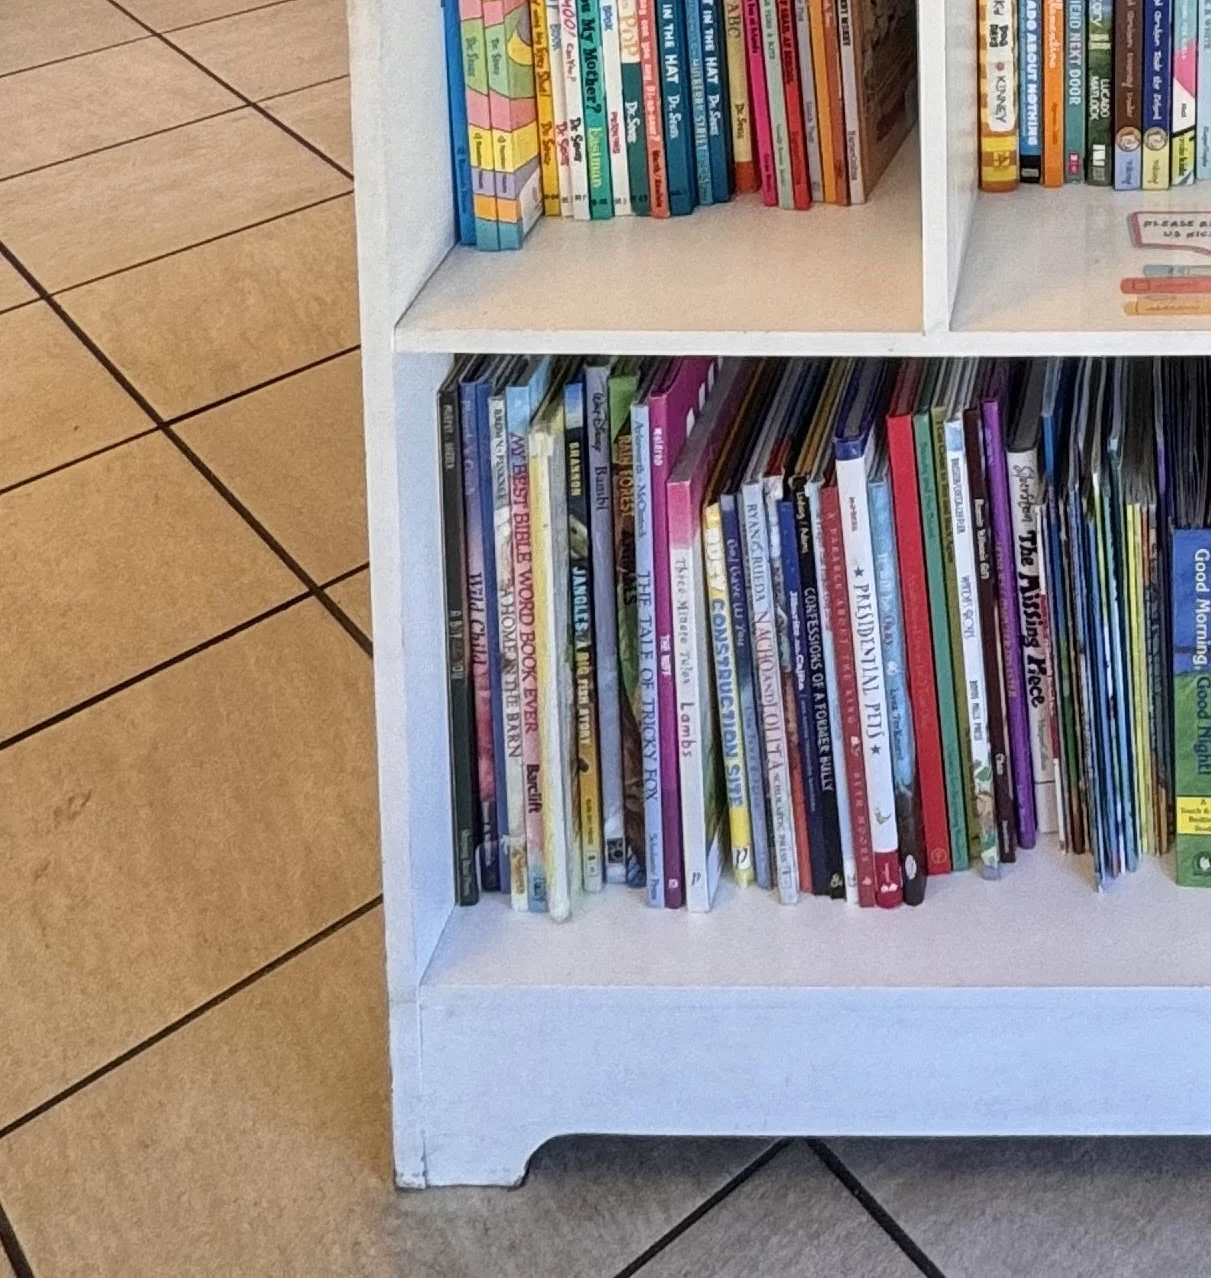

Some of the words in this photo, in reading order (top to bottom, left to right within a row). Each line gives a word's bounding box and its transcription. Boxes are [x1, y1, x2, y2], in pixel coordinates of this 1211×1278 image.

[580, 19, 595, 43] My
[663, 4, 673, 19] IN
[703, 11, 714, 24] IN
[1026, 0, 1036, 29] ADO
[663, 23, 675, 48] THE
[704, 28, 715, 52] THE
[1027, 33, 1037, 80] ABOUT
[1069, 33, 1081, 65] NEXT
[584, 48, 602, 114] Mother?
[665, 54, 679, 84] HAT
[705, 57, 719, 85] HAT
[1069, 69, 1081, 105] DOOR
[995, 75, 1007, 123] KINNEY
[1027, 83, 1037, 145] NOTHING
[1090, 76, 1099, 121] MATLOCK
[1100, 79, 1110, 118] LUCADO
[1143, 220, 1195, 228] PLEASE
[511, 432, 526, 461] MY
[618, 435, 633, 465] RAIN
[512, 465, 528, 509] BEST
[594, 466, 609, 511] Bambi
[619, 470, 634, 517] FOREST
[513, 512, 531, 563] BIBLE
[1020, 531, 1037, 567] The
[637, 570, 652, 606] THE
[1195, 548, 1210, 592] Good
[468, 572, 485, 613] Wild
[517, 568, 535, 625] WORD
[1018, 572, 1043, 648] Missing
[640, 612, 652, 660] TALE
[804, 587, 822, 671] CONFESSIONS
[853, 583, 880, 695] PRESIDENTIAL
[1191, 597, 1211, 671] Morning,
[521, 632, 536, 684] BOOK
[640, 668, 654, 691] OF
[711, 598, 740, 758] CONSTRUCTION
[812, 674, 824, 688] OF
[1026, 654, 1047, 708] Piece
[1196, 676, 1211, 720] Good
[524, 688, 538, 734] EVER
[641, 700, 656, 762] TRICKY
[680, 702, 695, 758] Lambs
[815, 704, 829, 754] FORMER
[864, 703, 885, 739] PETS
[507, 713, 522, 758] BARN
[1194, 725, 1211, 775] Night!
[526, 764, 543, 814] Barclift
[644, 769, 657, 803] FOX
[725, 762, 744, 807] SITE
[820, 756, 833, 792] BULLY
